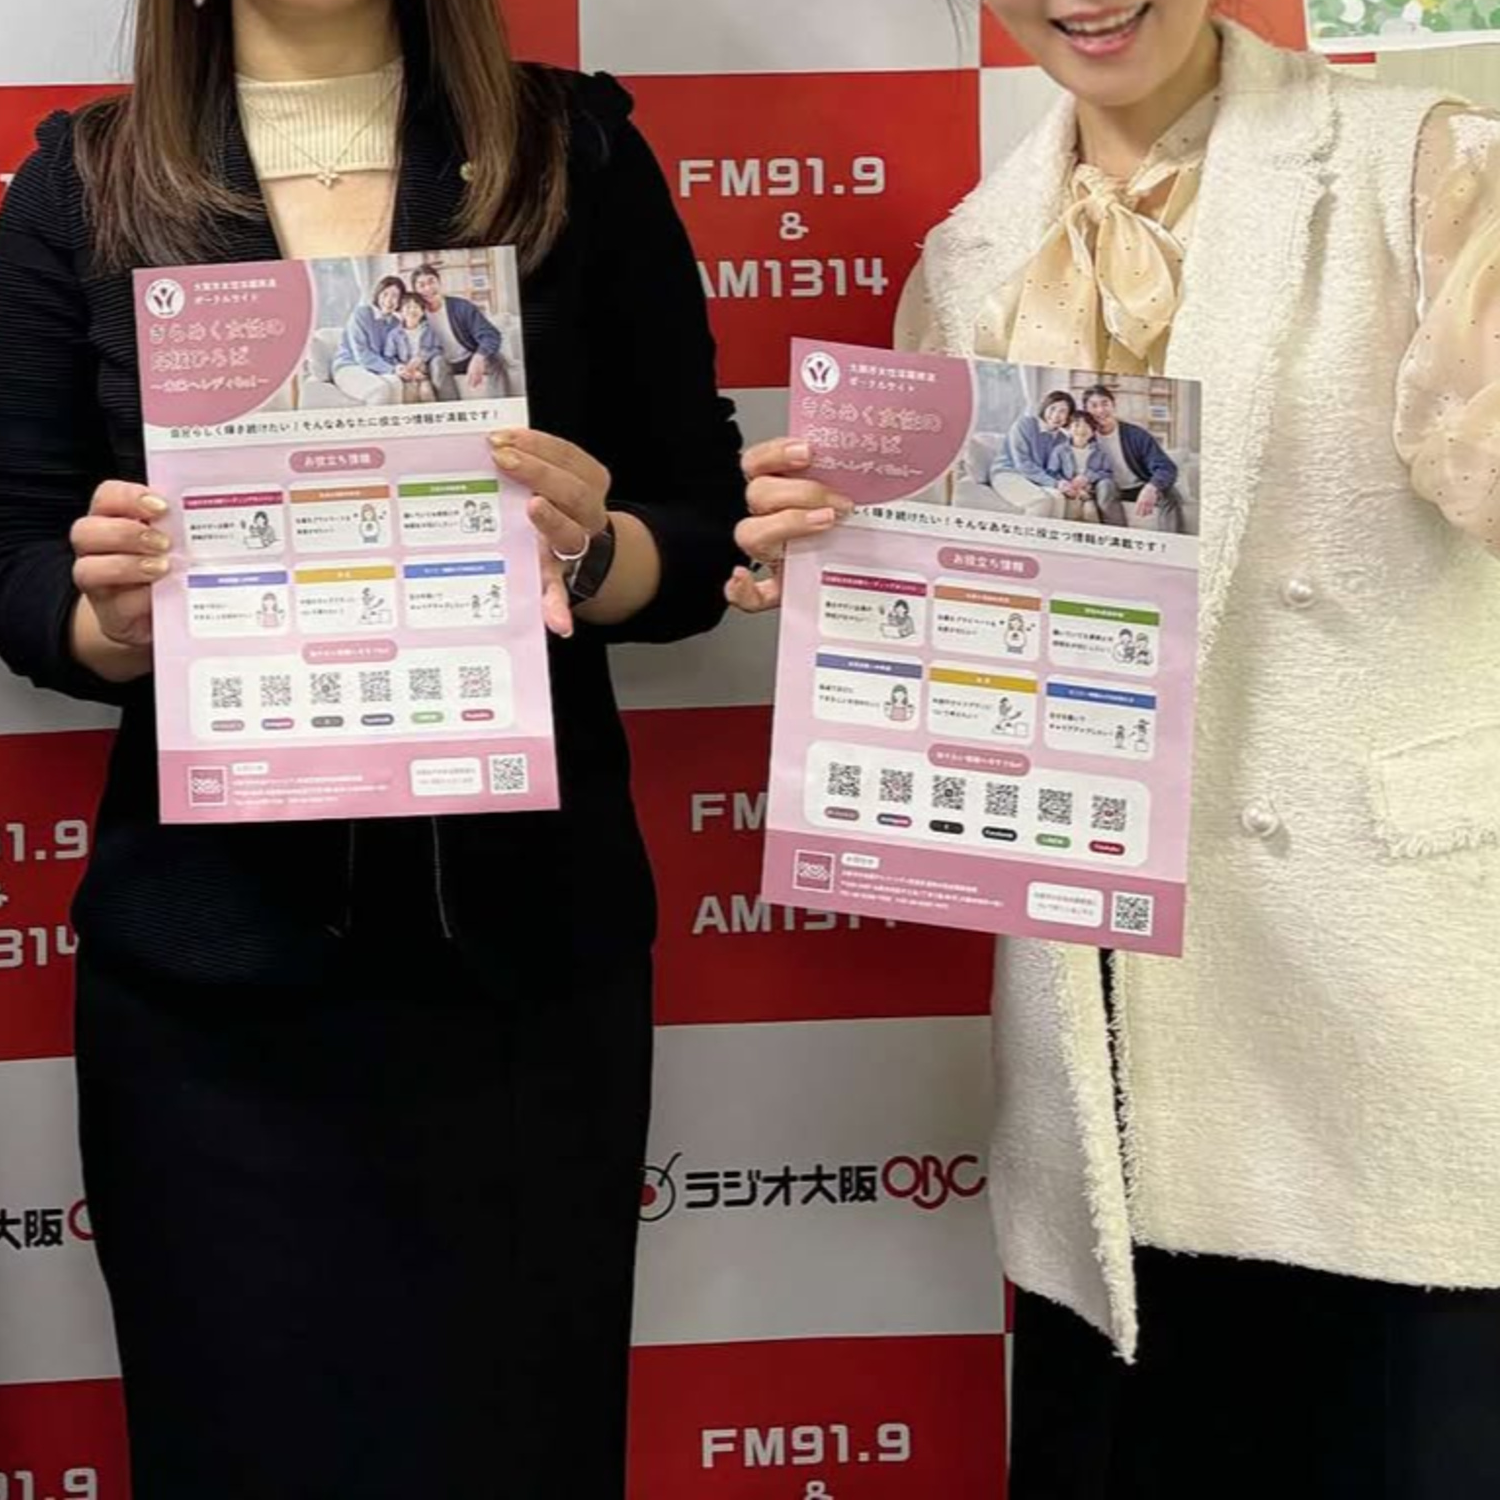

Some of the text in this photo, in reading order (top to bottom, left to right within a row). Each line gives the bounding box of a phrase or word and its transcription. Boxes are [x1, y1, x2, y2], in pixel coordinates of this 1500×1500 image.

[679, 156, 886, 197] FM91.9
[779, 212, 809, 240] &
[702, 1422, 911, 1468] FM91.9
